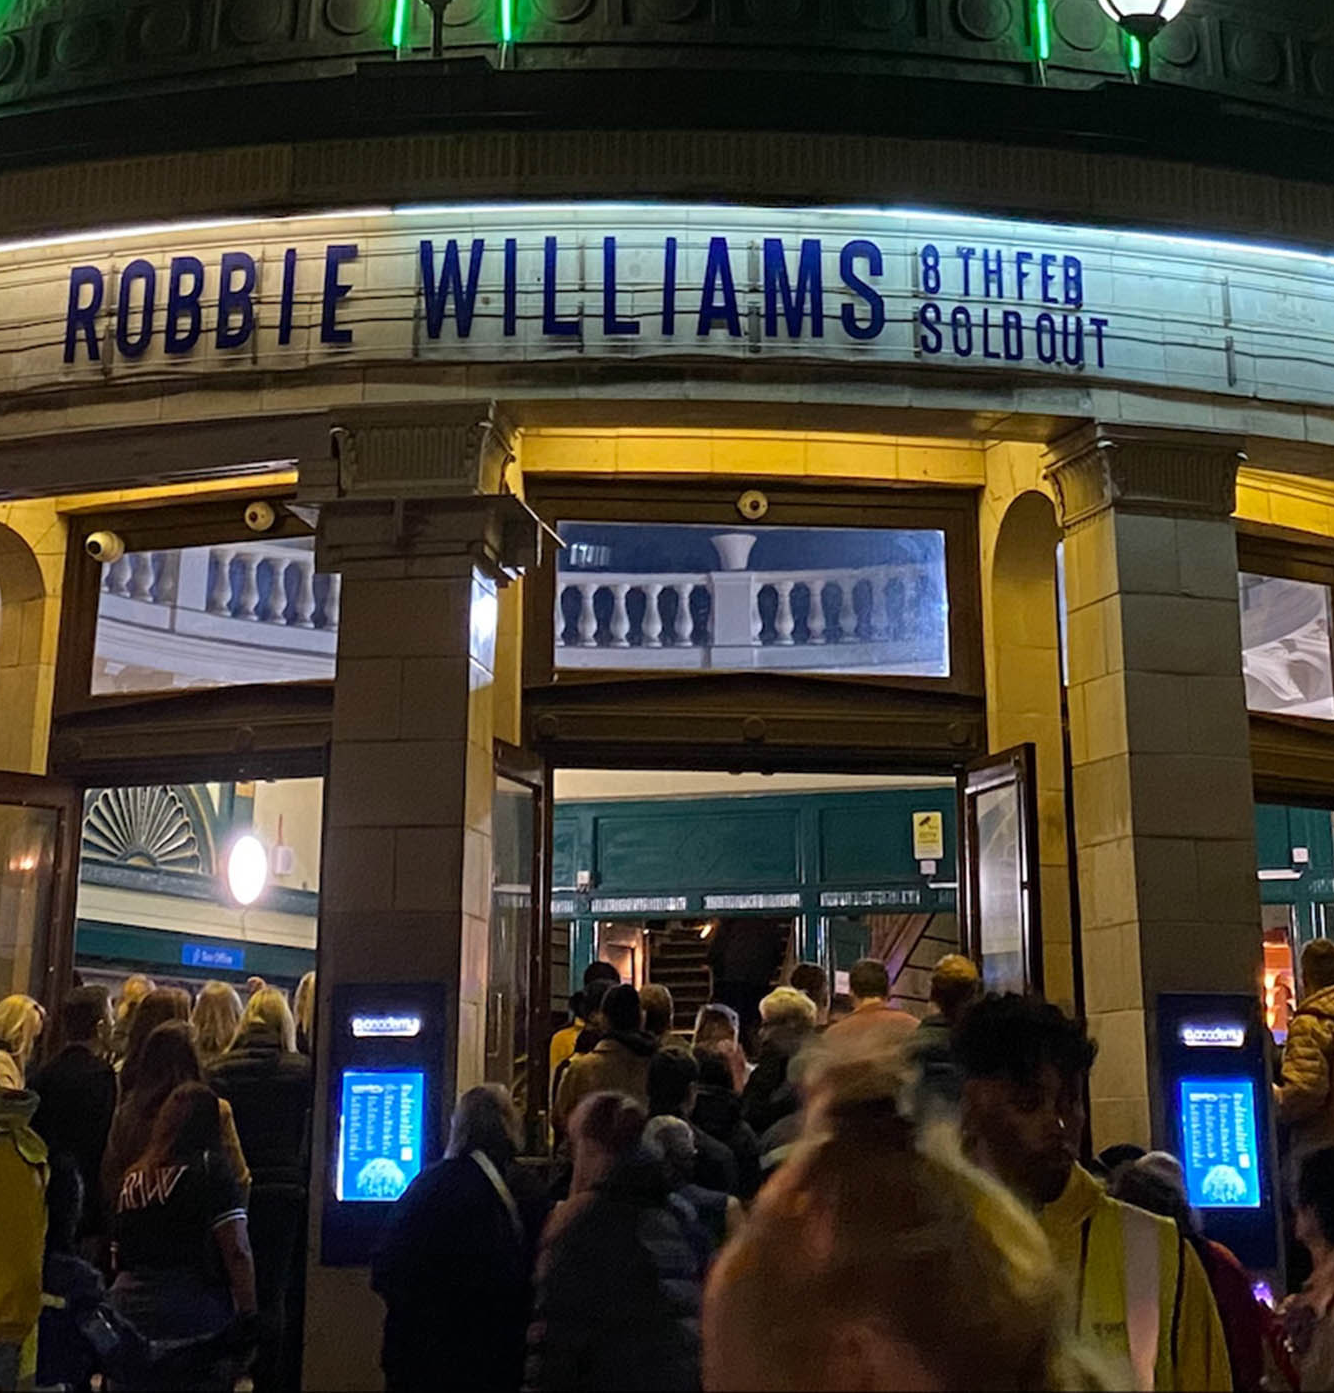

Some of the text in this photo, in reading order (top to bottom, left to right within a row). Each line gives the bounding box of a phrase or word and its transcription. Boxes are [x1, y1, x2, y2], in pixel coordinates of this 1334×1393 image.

[63, 236, 884, 364] ROBBIE WILLIAMS
[919, 303, 1109, 369] SOLD OUT
